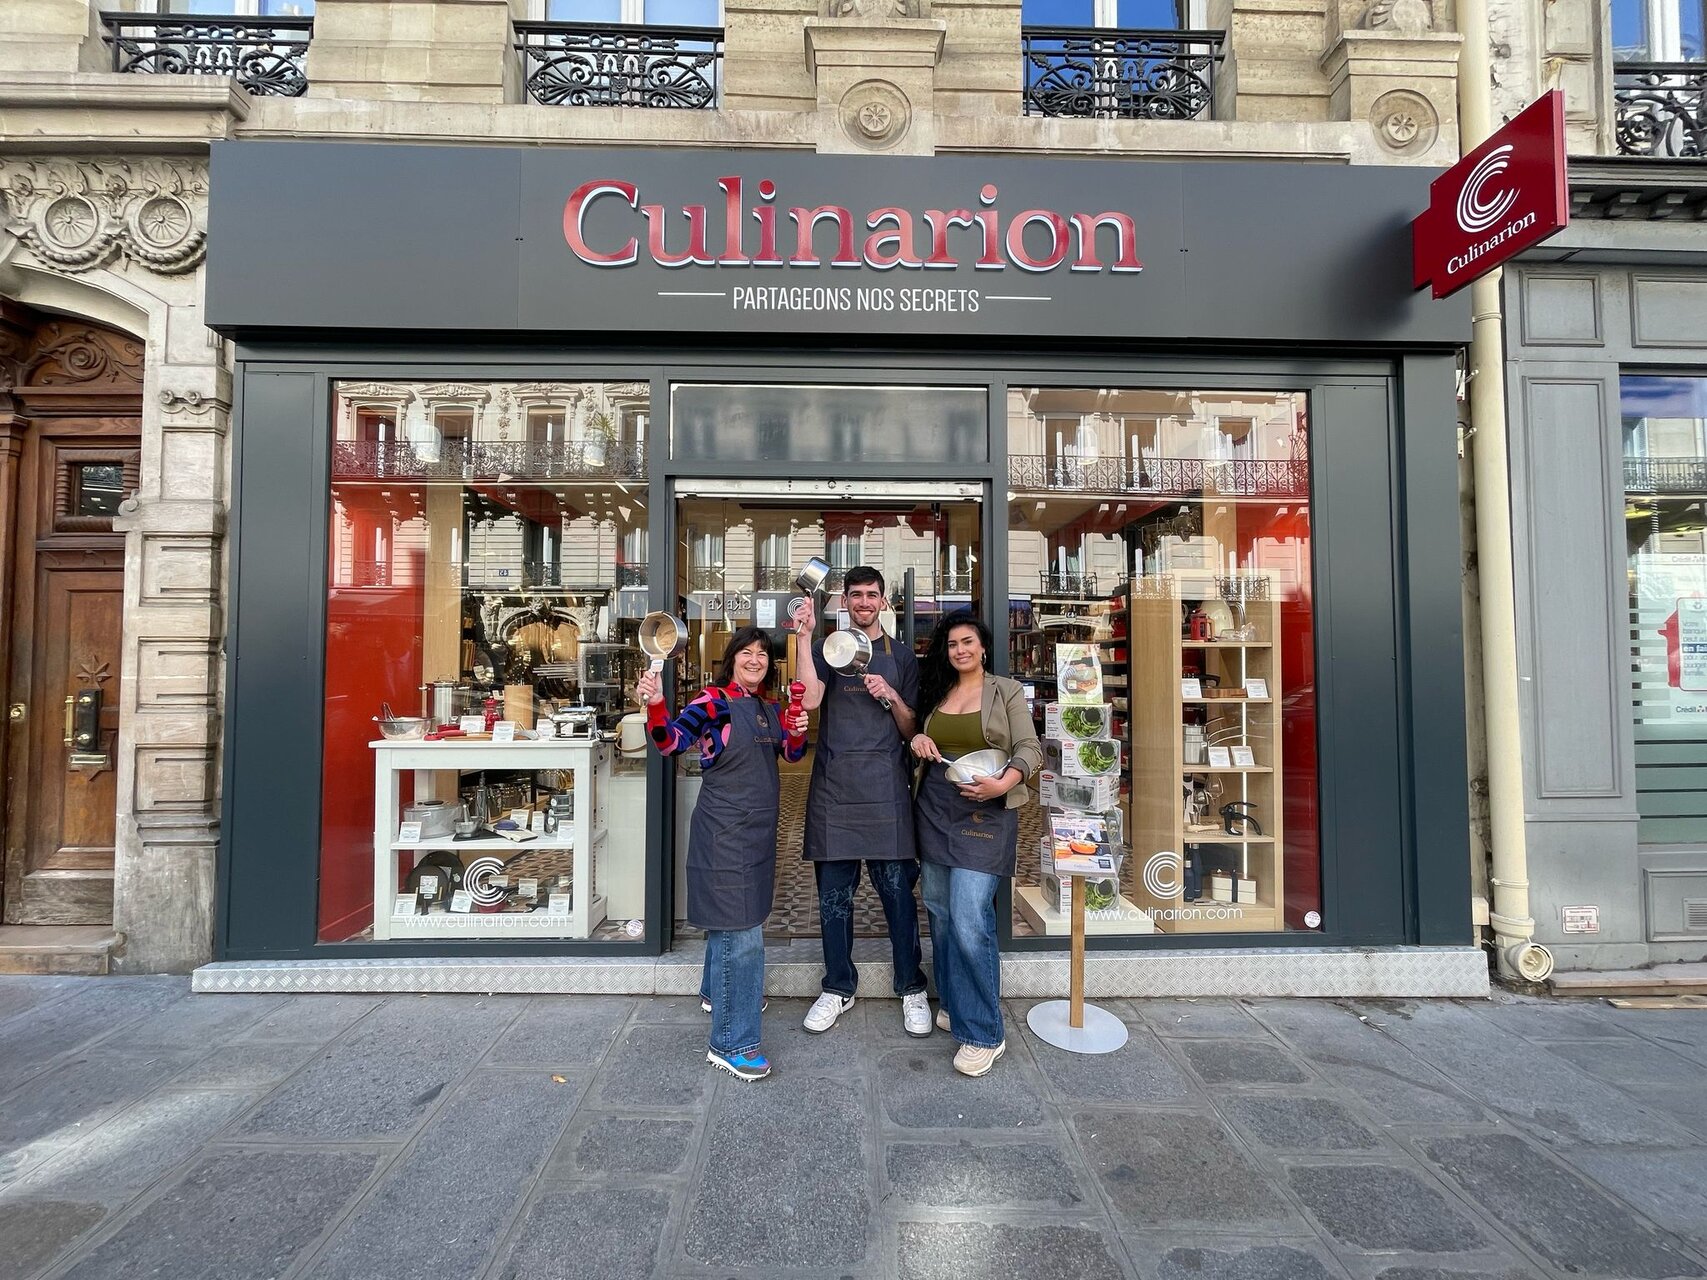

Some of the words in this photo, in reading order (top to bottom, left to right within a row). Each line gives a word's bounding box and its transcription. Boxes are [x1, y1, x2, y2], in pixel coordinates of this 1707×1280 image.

[563, 176, 1144, 273] Culinarion
[1447, 211, 1537, 275] Culinarion
[733, 287, 851, 311] PARTAGEONS
[857, 288, 894, 311] NOS
[899, 289, 979, 313] SECRETS
[1676, 705, 1697, 713] Crédit
[403, 914, 567, 929] www.culinarion.com
[1087, 906, 1243, 921] www.culinarion.com
